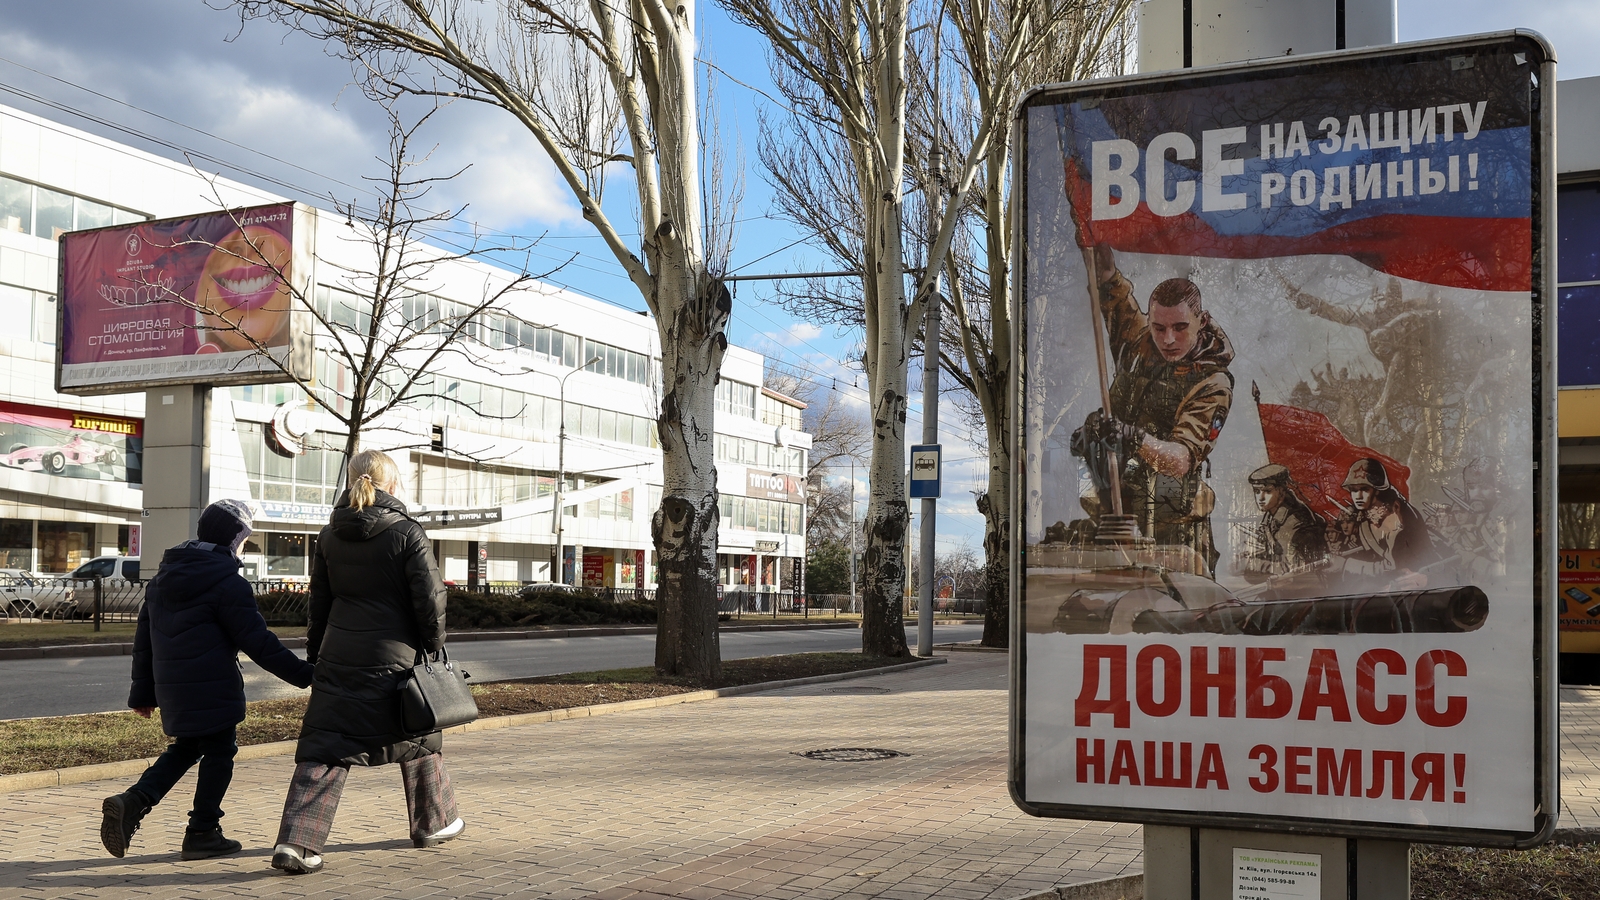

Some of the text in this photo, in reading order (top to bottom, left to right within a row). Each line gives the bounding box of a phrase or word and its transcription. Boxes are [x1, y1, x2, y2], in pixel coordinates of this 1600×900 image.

[1260, 101, 1488, 160] НА ЗАЩИТУ
[1091, 126, 1248, 220] ВСЕ
[1261, 153, 1479, 211] РОДИНЫ!
[255, 213, 287, 223] 474-47-72
[103, 318, 171, 333] ЦИФРОВАЯ
[88, 328, 184, 346] СТОМАТОЛОГИЯ
[749, 473, 784, 491] TATTOO
[264, 503, 334, 515] АВТОШКО
[1559, 618, 1600, 626] кумент
[1074, 643, 1468, 729] ДОНБАСС
[1075, 738, 1467, 804] НАША ЗЕМЛЯ!
